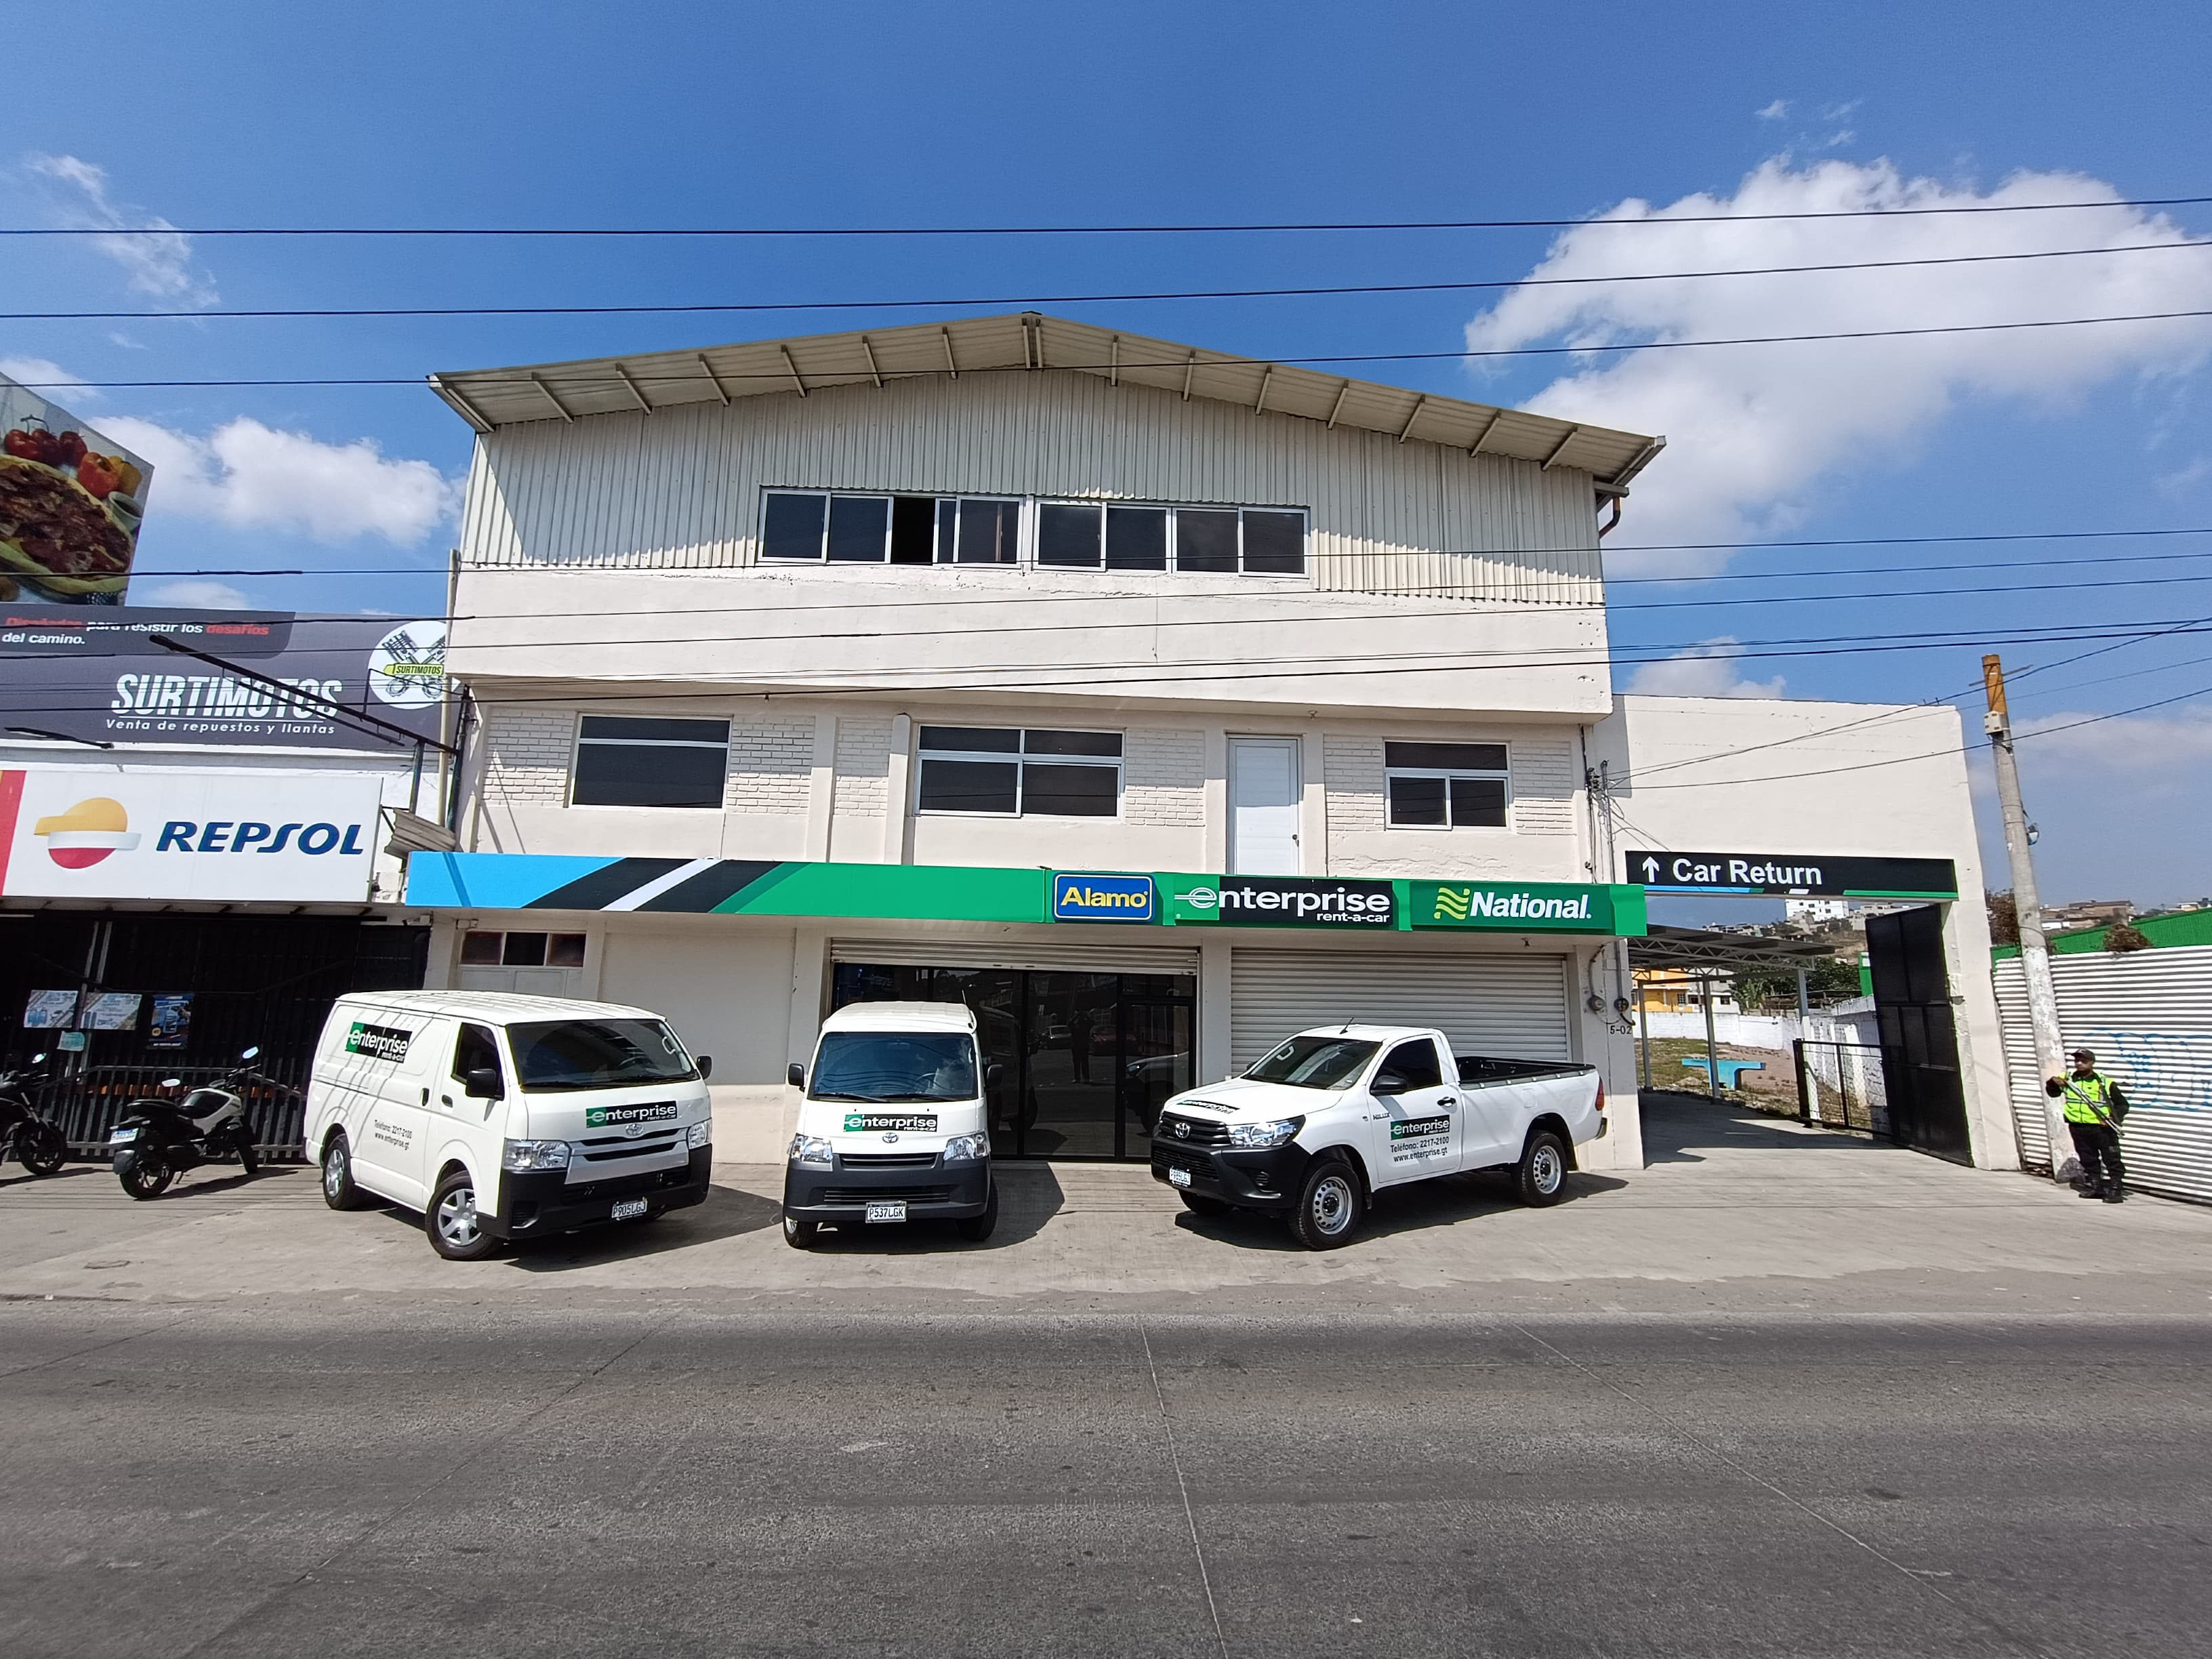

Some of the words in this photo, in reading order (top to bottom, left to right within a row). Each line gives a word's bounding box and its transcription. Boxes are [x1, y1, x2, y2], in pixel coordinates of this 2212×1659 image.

[181, 623, 203, 634] los
[2, 633, 26, 642] del
[28, 634, 85, 644] camino.
[395, 665, 442, 674] SURTIMOTOS
[110, 673, 343, 720] SURTIMOTOS
[106, 718, 150, 731] Venta
[157, 720, 177, 731] de
[182, 721, 260, 733] repuestos
[266, 724, 276, 735] y
[281, 722, 335, 734] llantas
[156, 821, 364, 855] REPSOL
[1672, 858, 1721, 883] Car
[1729, 859, 1822, 886] Return
[1060, 886, 1147, 908] Alamo
[1174, 886, 1390, 917] enterprise
[1316, 912, 1390, 923] rent-a-car
[1610, 1025, 1632, 1035] 5-02
[349, 1029, 409, 1055] enterprise
[586, 1105, 676, 1122] enterprise
[844, 1116, 937, 1130] enterprise
[1391, 1119, 1450, 1135] enterprise
[1390, 1142, 1419, 1153] Teléfono:
[1420, 1136, 1450, 1148] 2217-2100
[1393, 1147, 1448, 1162] www.enterprise.gt
[869, 1207, 904, 1218] P537LGK
